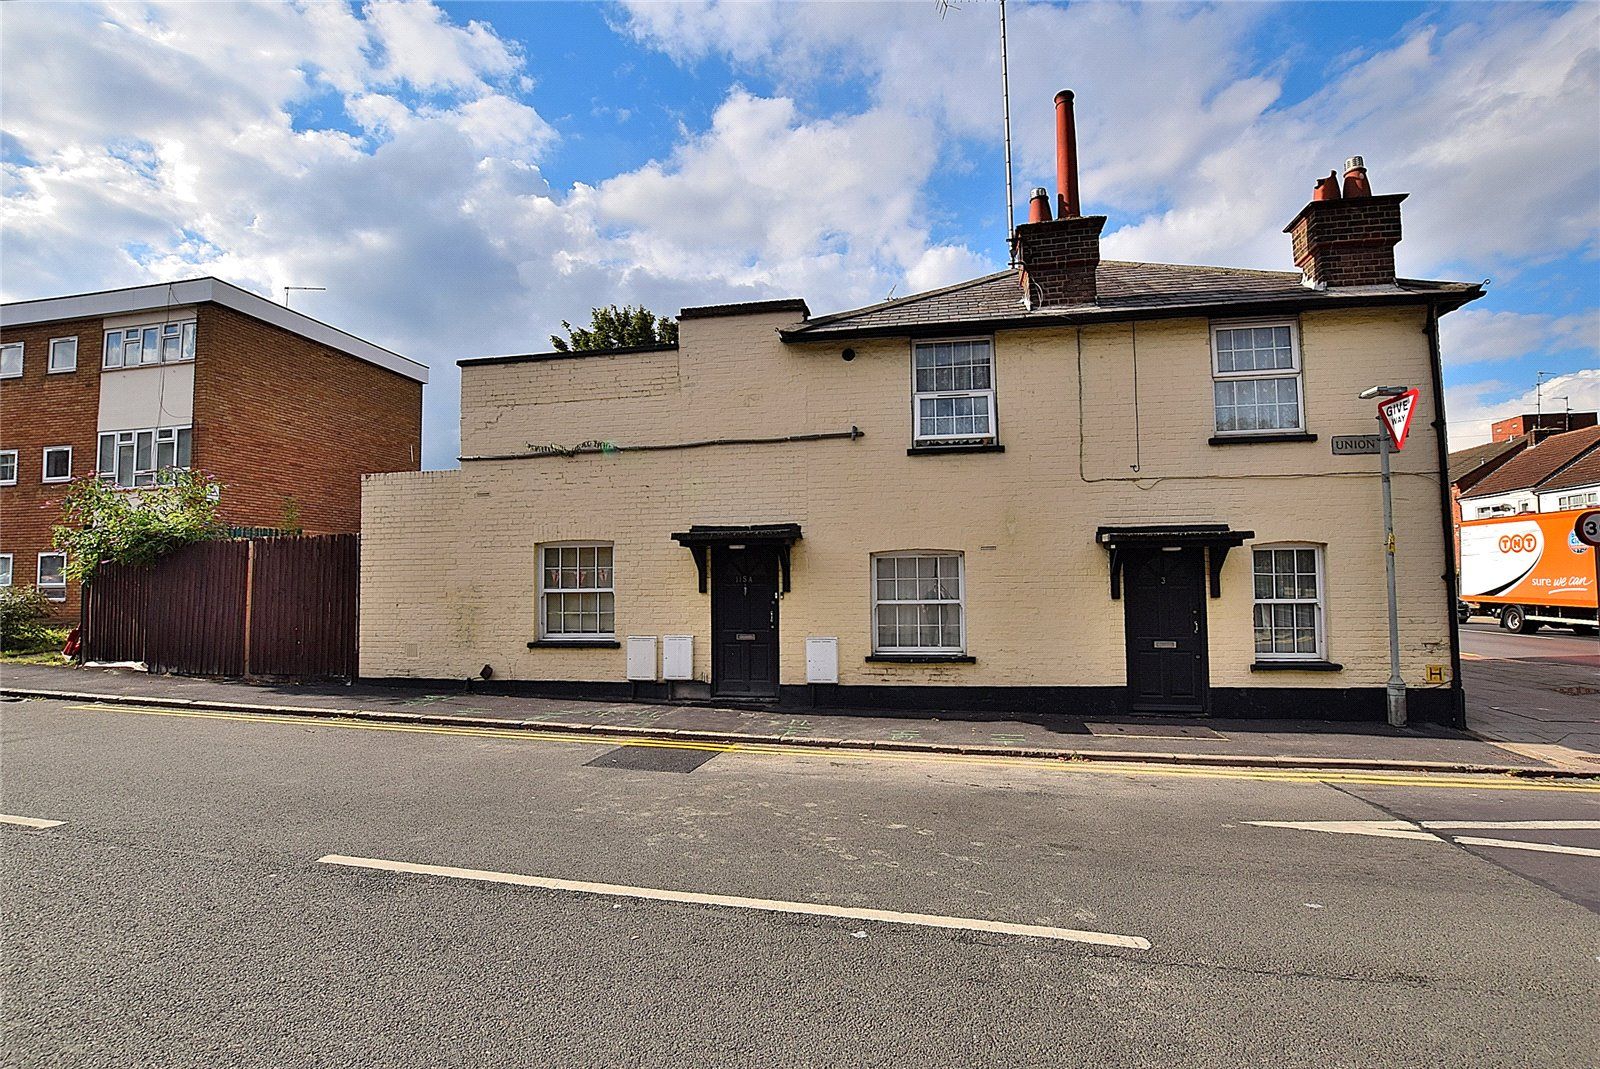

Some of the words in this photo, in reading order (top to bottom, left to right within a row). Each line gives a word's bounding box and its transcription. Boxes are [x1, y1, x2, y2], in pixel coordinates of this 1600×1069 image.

[1386, 400, 1409, 417] GIVE
[1391, 414, 1406, 425] WAY
[1335, 440, 1375, 449] UNION
[1500, 535, 1535, 551] TNT
[1161, 576, 1166, 584] 3
[1532, 578, 1551, 586] sure
[1553, 577, 1566, 586] we
[1568, 576, 1593, 585] can
[1429, 667, 1442, 680] H
